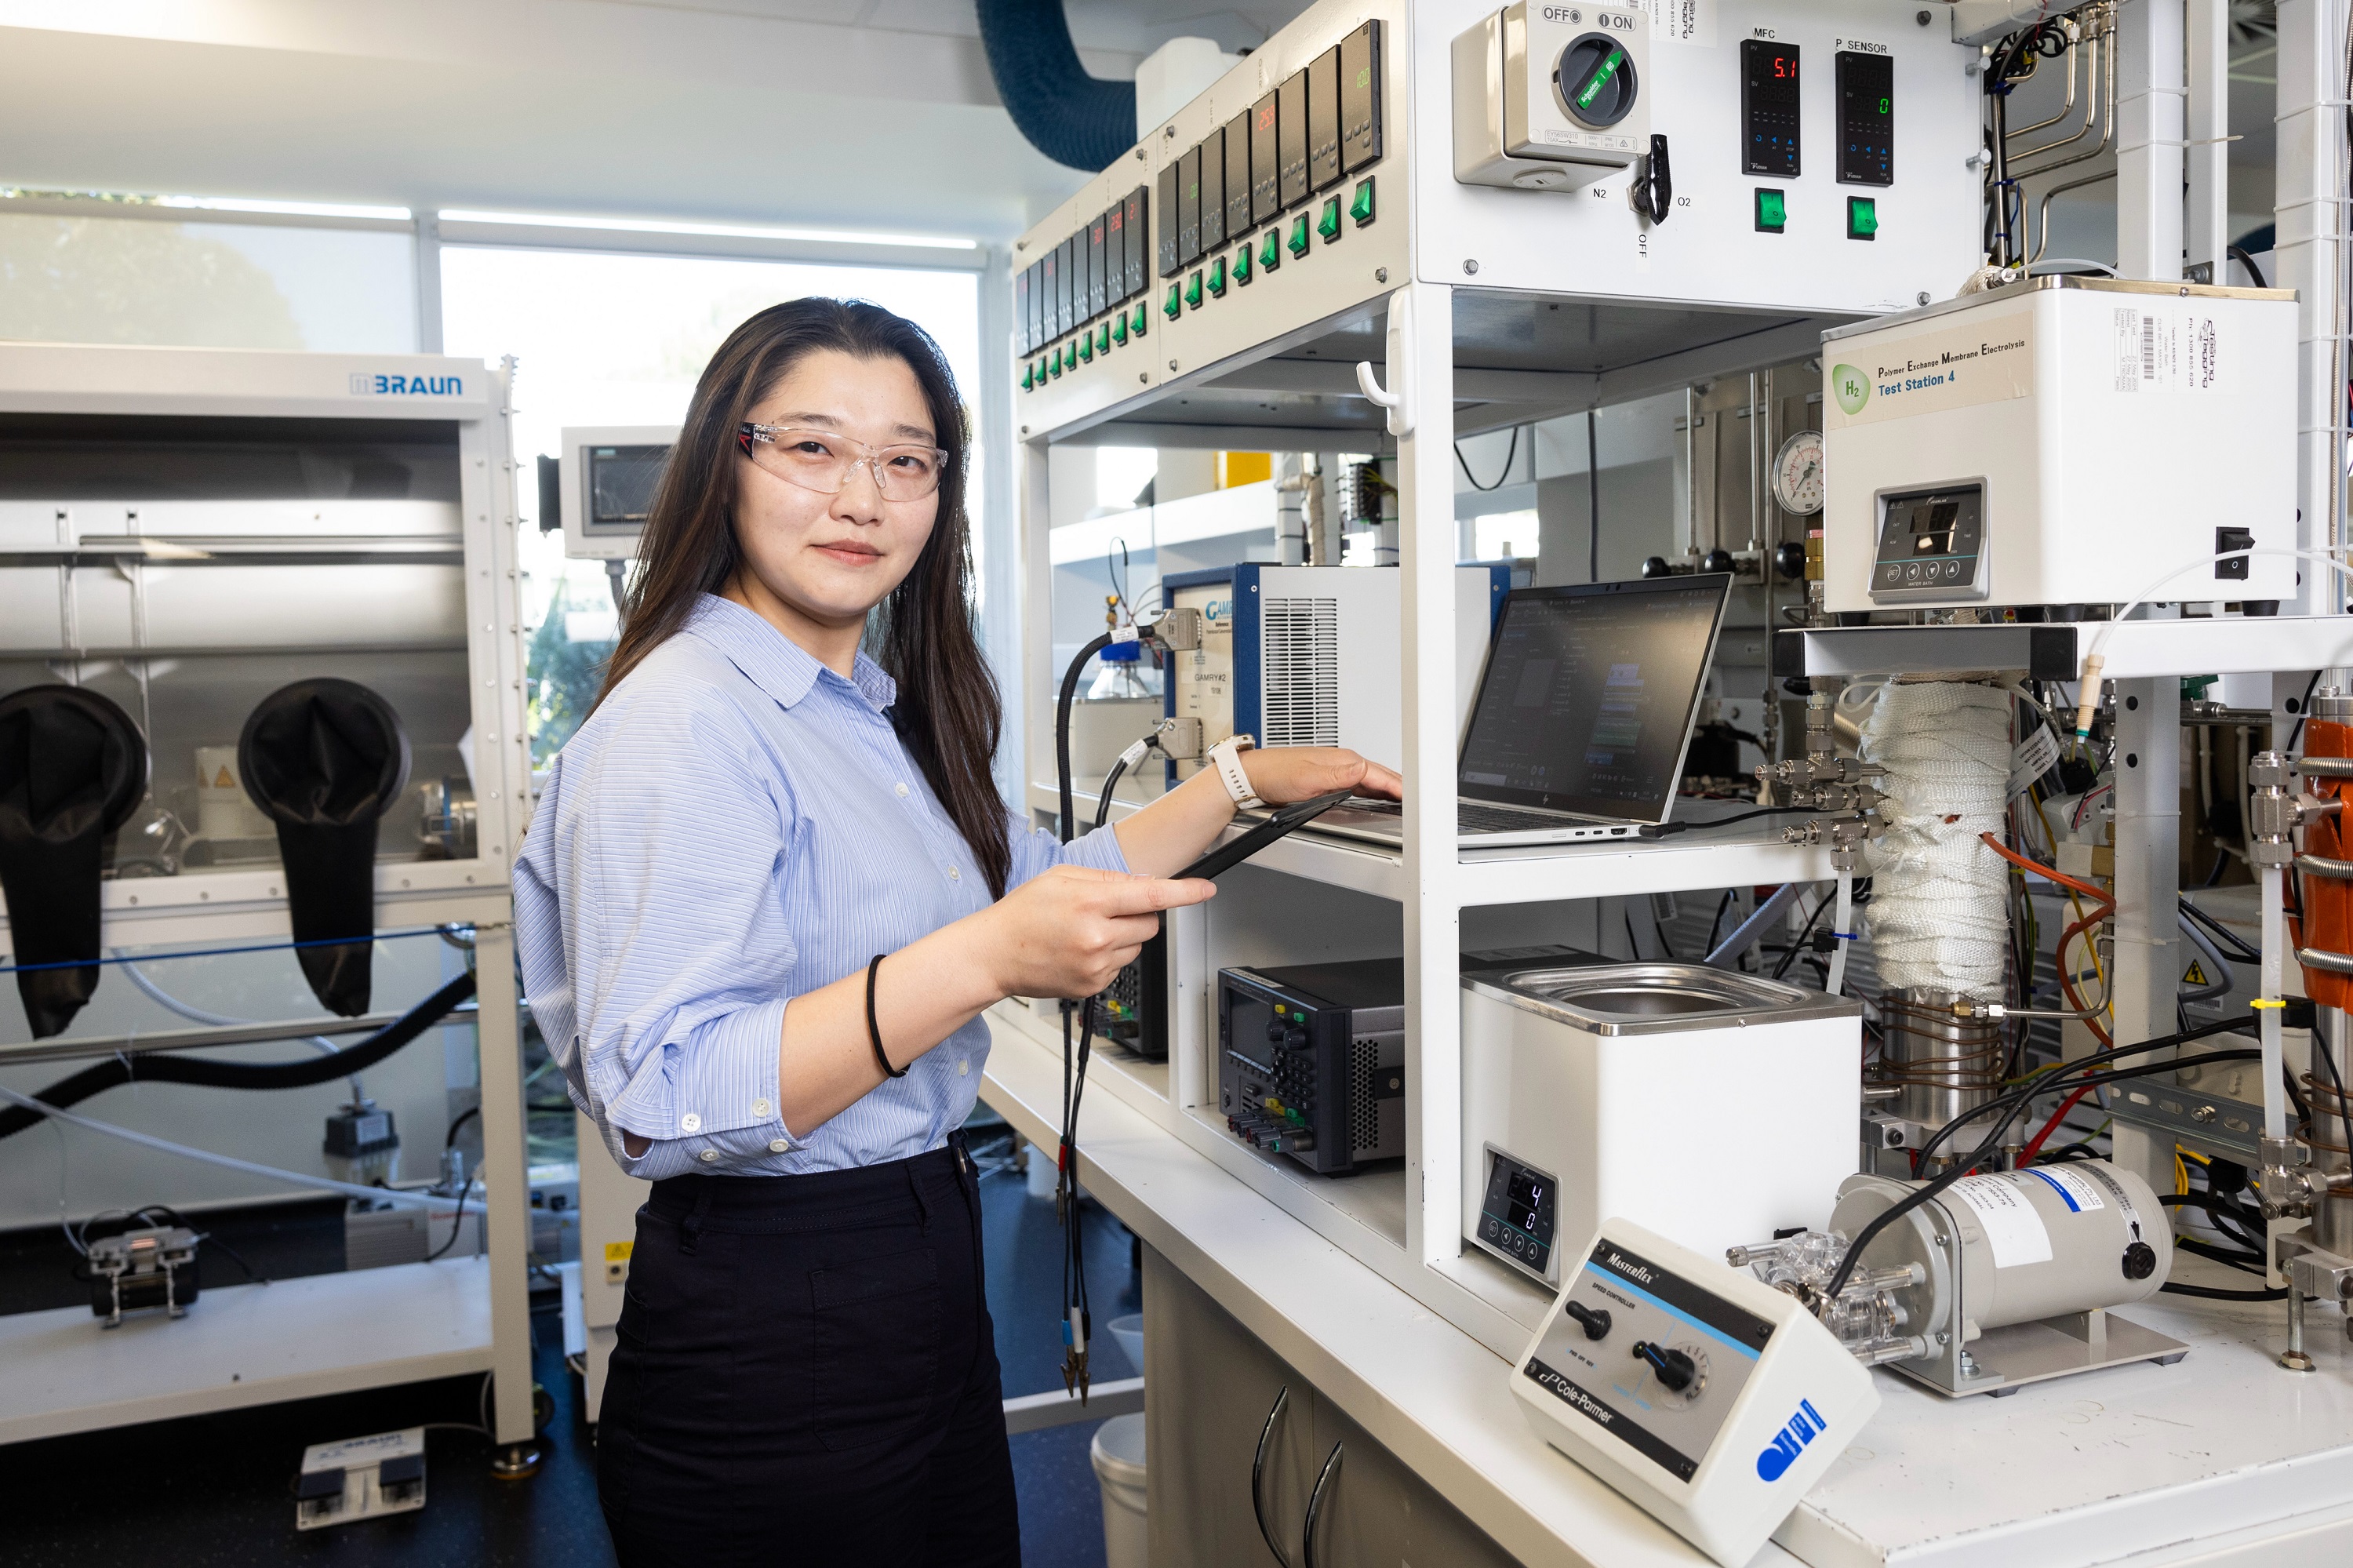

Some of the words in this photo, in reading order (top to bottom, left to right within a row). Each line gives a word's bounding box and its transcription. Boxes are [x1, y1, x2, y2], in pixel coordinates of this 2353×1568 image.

[1544, 7, 1569, 21] OFF
[1613, 16, 1631, 30] ON
[1755, 27, 1775, 38] MFC
[1848, 41, 1887, 53] SENSOR
[1774, 57, 1796, 78] 5.1
[1879, 98, 1889, 114] 0
[1593, 188, 1606, 198] N2
[1678, 197, 1690, 206] O2
[1878, 366, 1905, 378] Polymer
[1907, 360, 1939, 371] Exchange
[1941, 352, 1978, 365] Membrane
[1981, 340, 2025, 355] Electrolysis
[1878, 382, 1901, 396] Test
[1905, 375, 1944, 391] Station
[1948, 370, 1955, 382] 4
[1206, 600, 1232, 620] GAMR
[1533, 1185, 1541, 1206] 4
[1993, 1184, 2017, 1207] Company
[2065, 1171, 2087, 1188] Scientific
[2093, 1196, 2101, 1205] Ltd
[1526, 1212, 1535, 1229] 0
[1592, 1282, 1607, 1293] SPEED
[1606, 1290, 1635, 1309] CONTROLLER
[1557, 1381, 1613, 1424] Cole-Parmer
